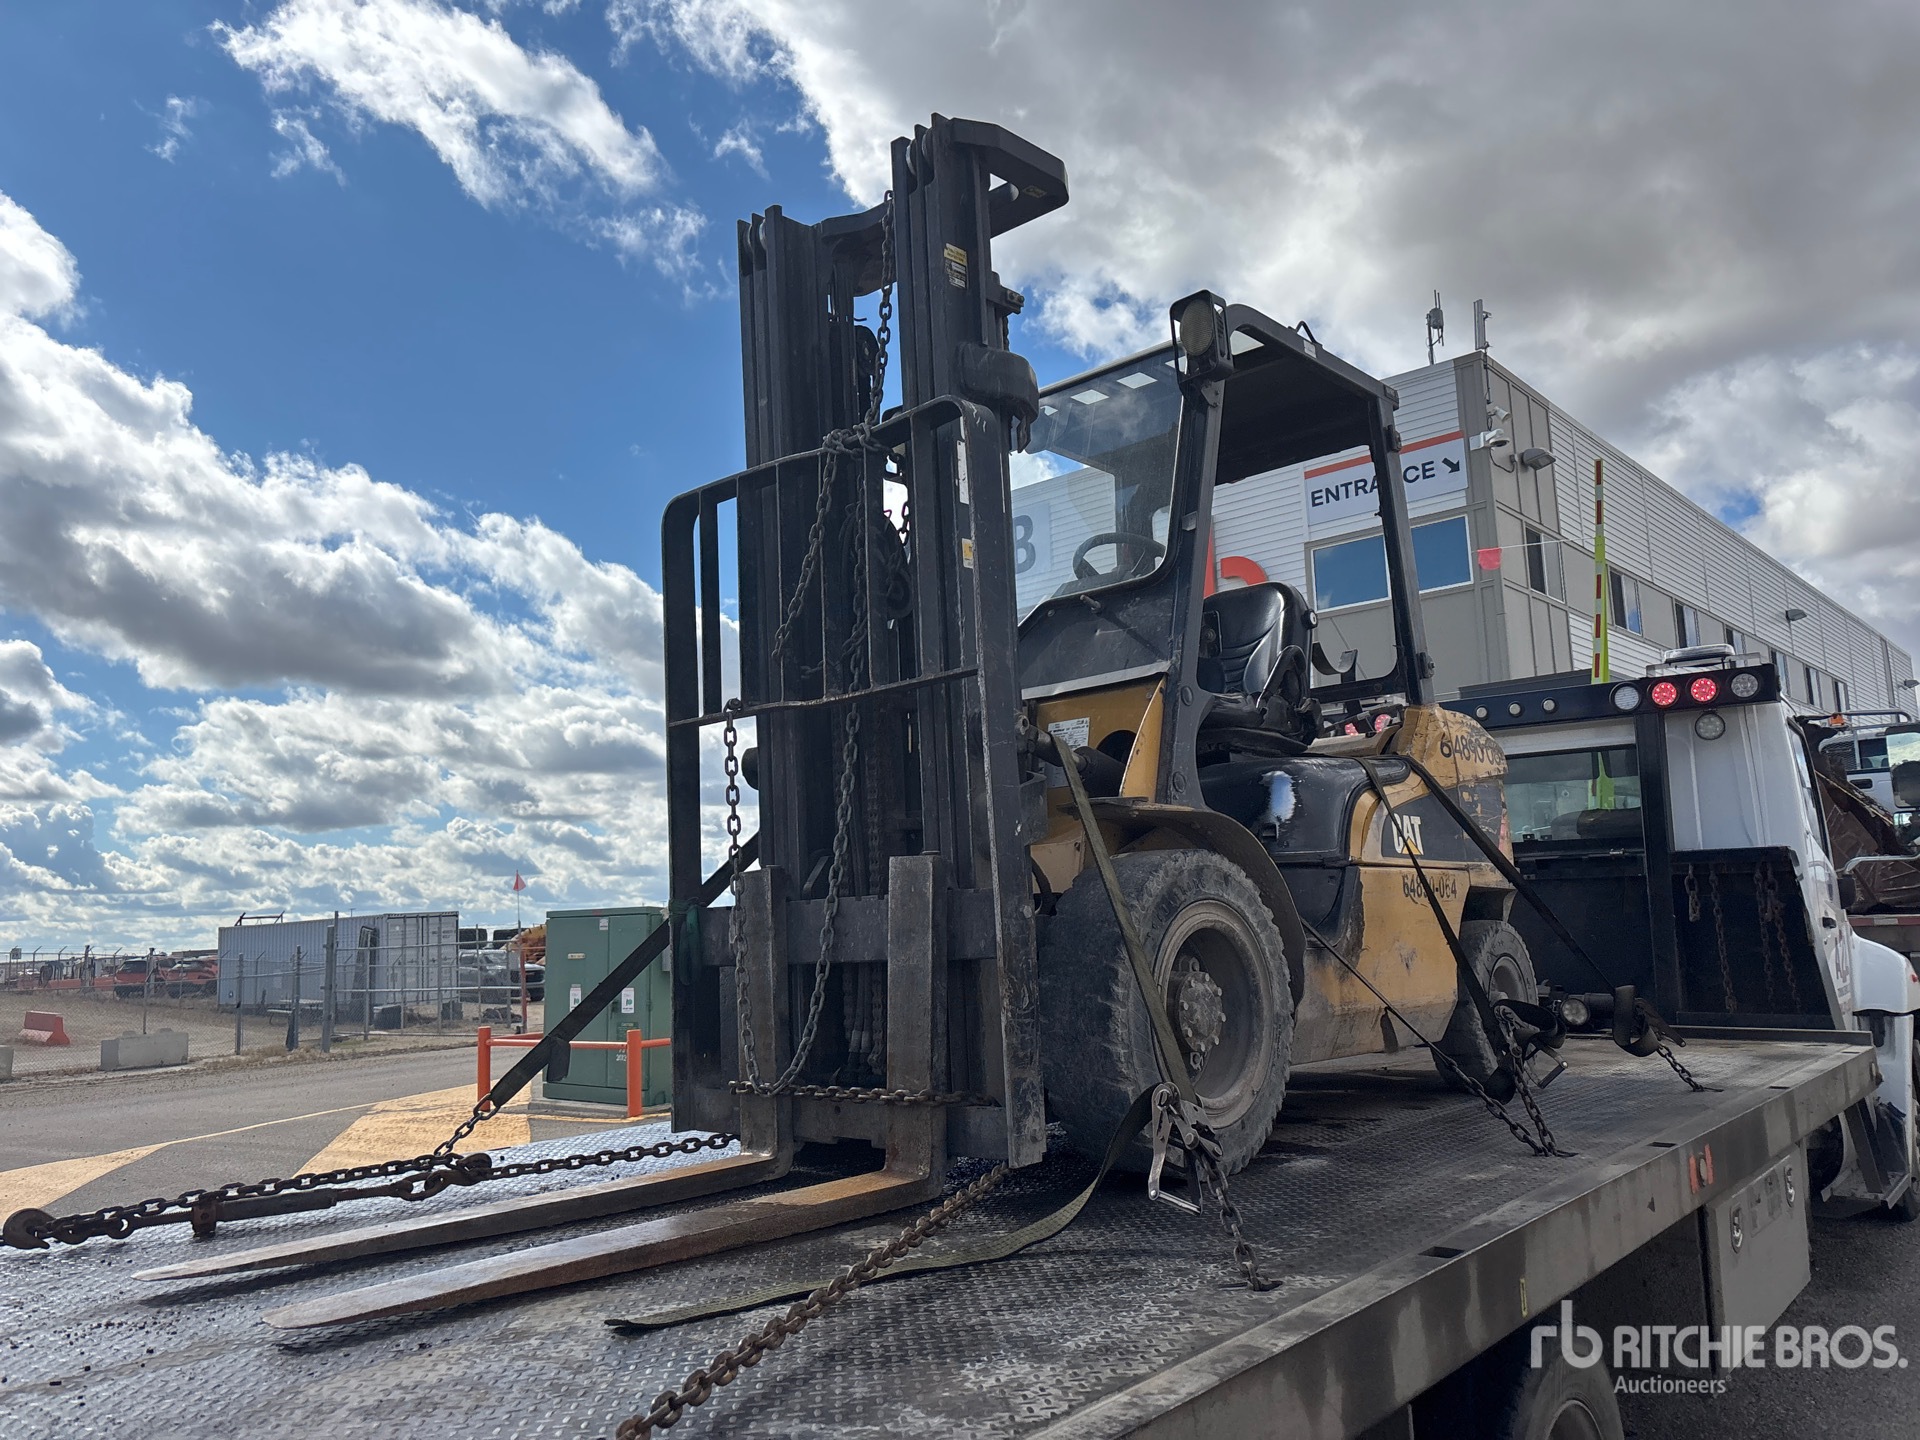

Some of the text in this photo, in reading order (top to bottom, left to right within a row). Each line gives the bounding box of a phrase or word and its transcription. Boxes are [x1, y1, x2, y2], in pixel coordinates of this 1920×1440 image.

[1311, 460, 1436, 507] ENTRACE
[1391, 812, 1424, 856] CAT
[1402, 873, 1457, 898] 6480-064
